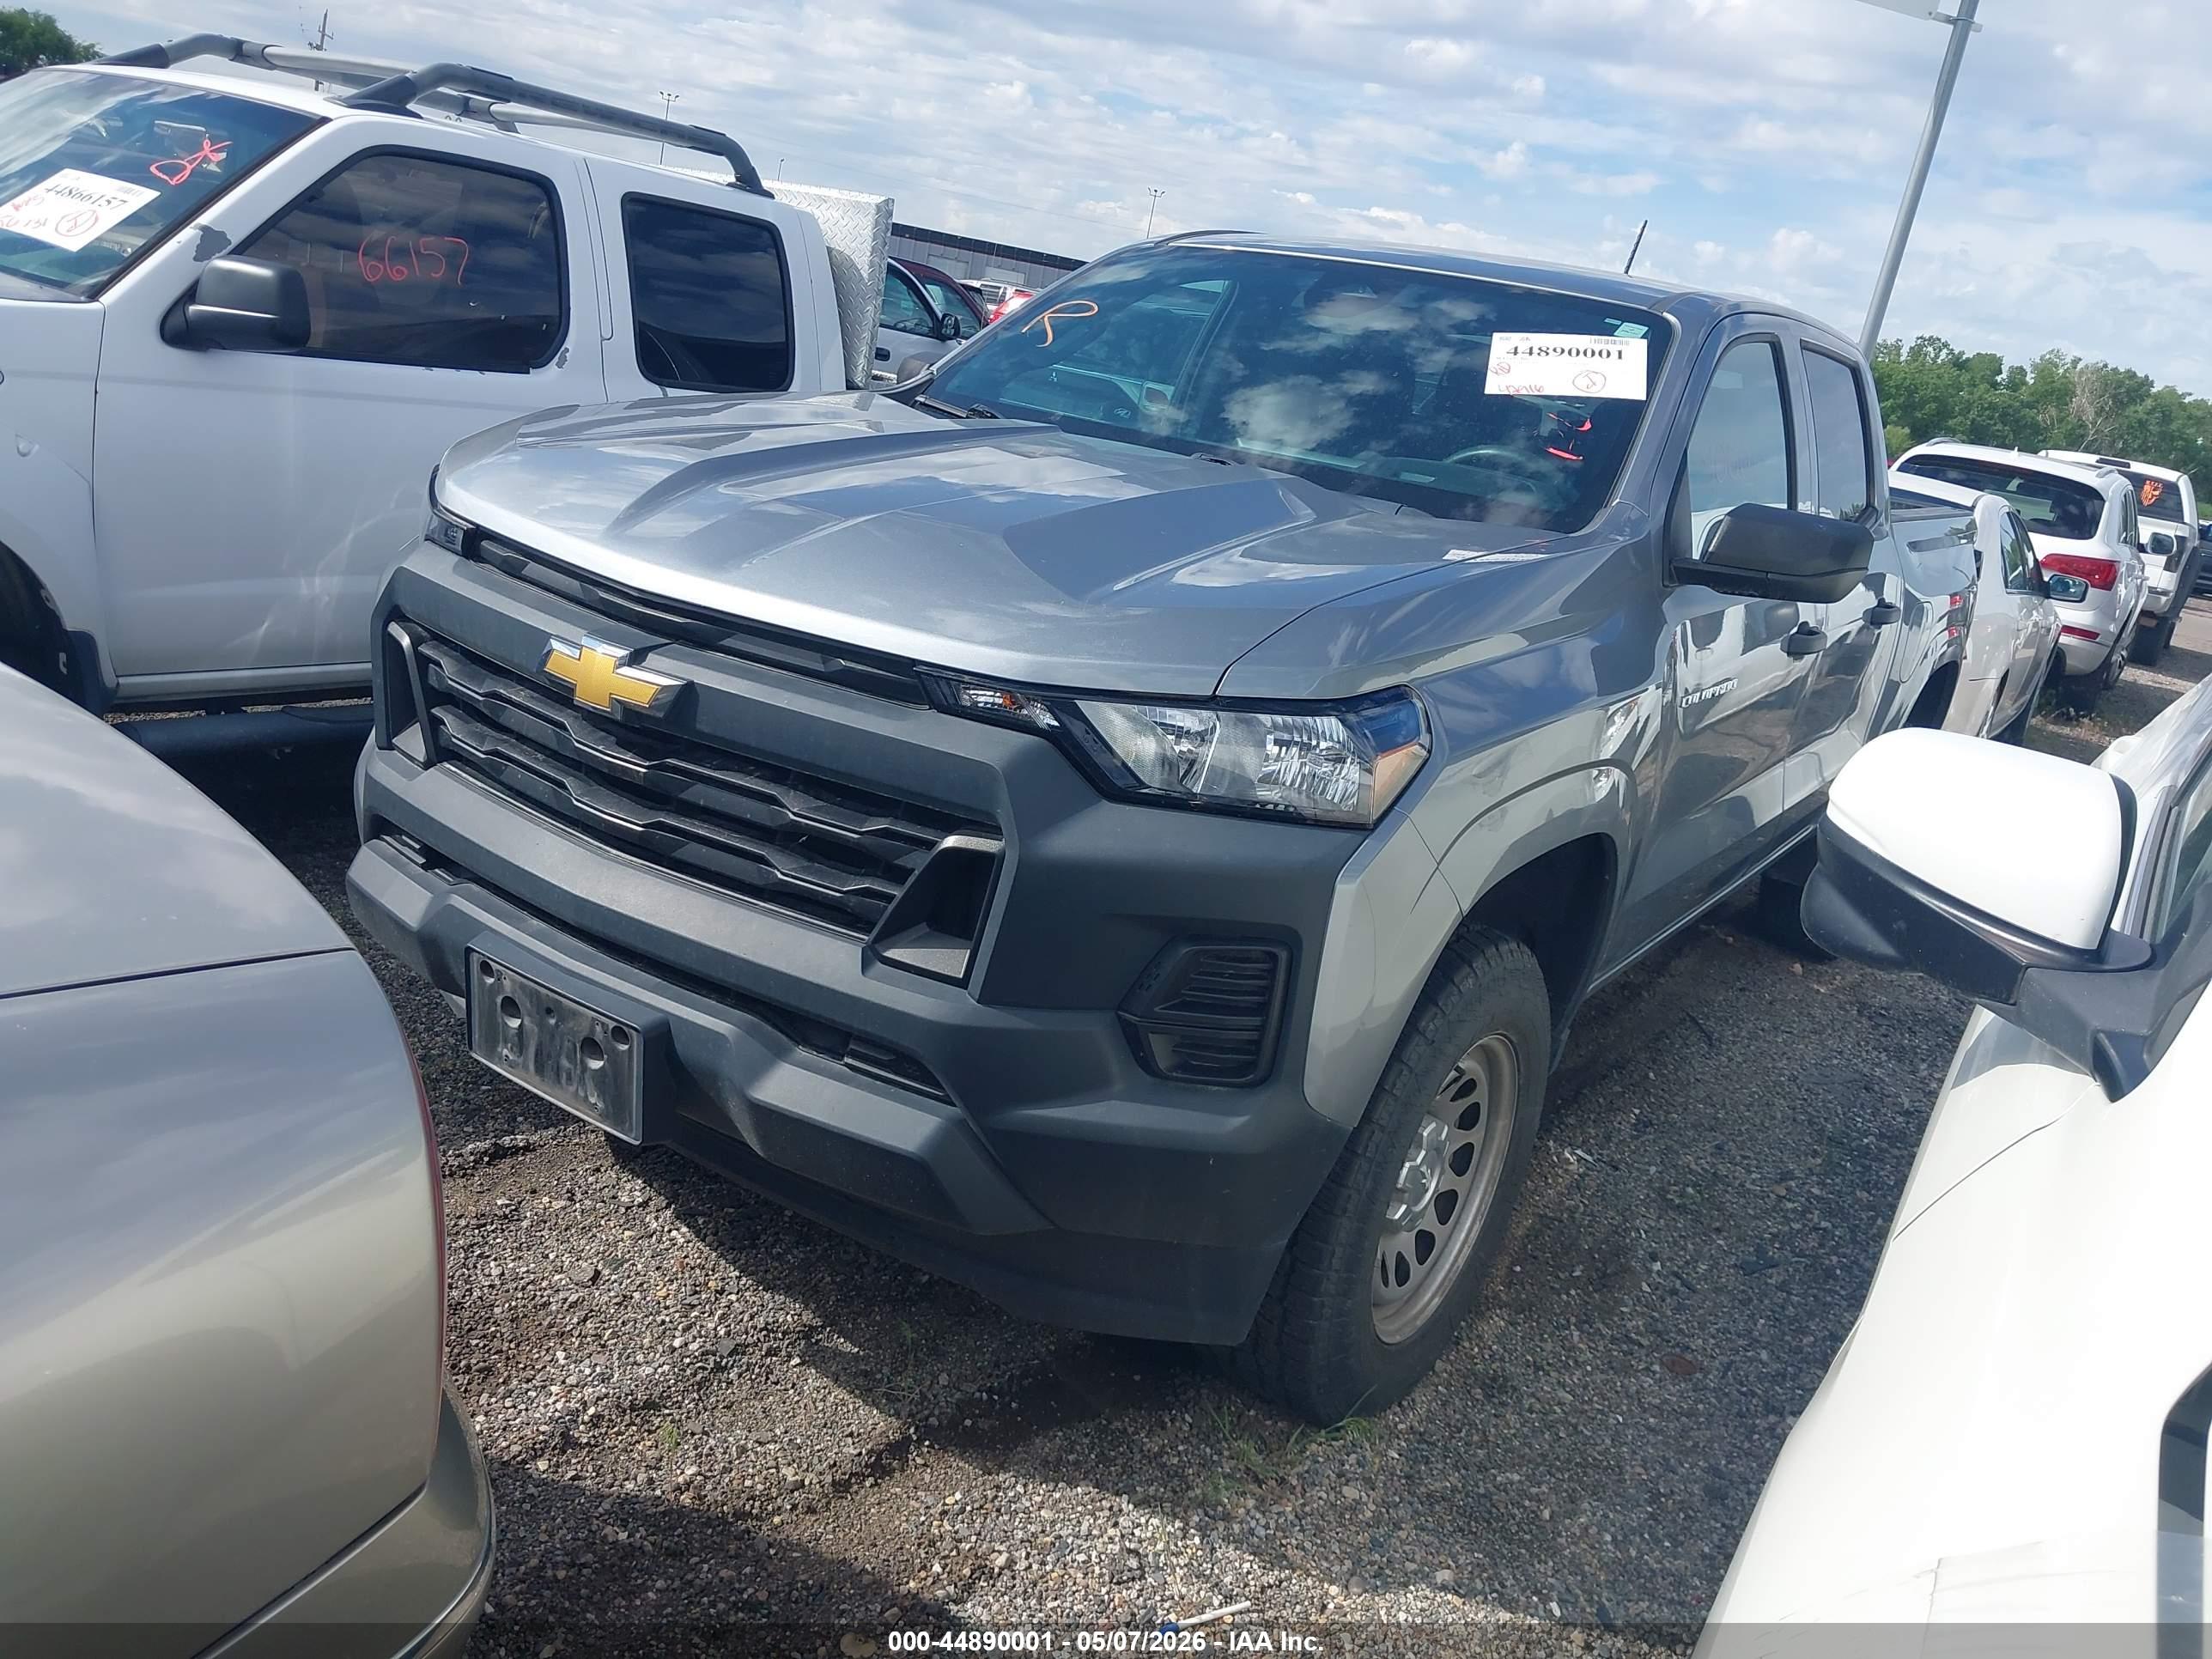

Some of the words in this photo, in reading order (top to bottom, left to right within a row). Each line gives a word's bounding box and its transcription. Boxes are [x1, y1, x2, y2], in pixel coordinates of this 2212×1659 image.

[46, 183, 128, 210] 44866157
[358, 231, 469, 286] 66157
[1506, 345, 1624, 361] 44890001
